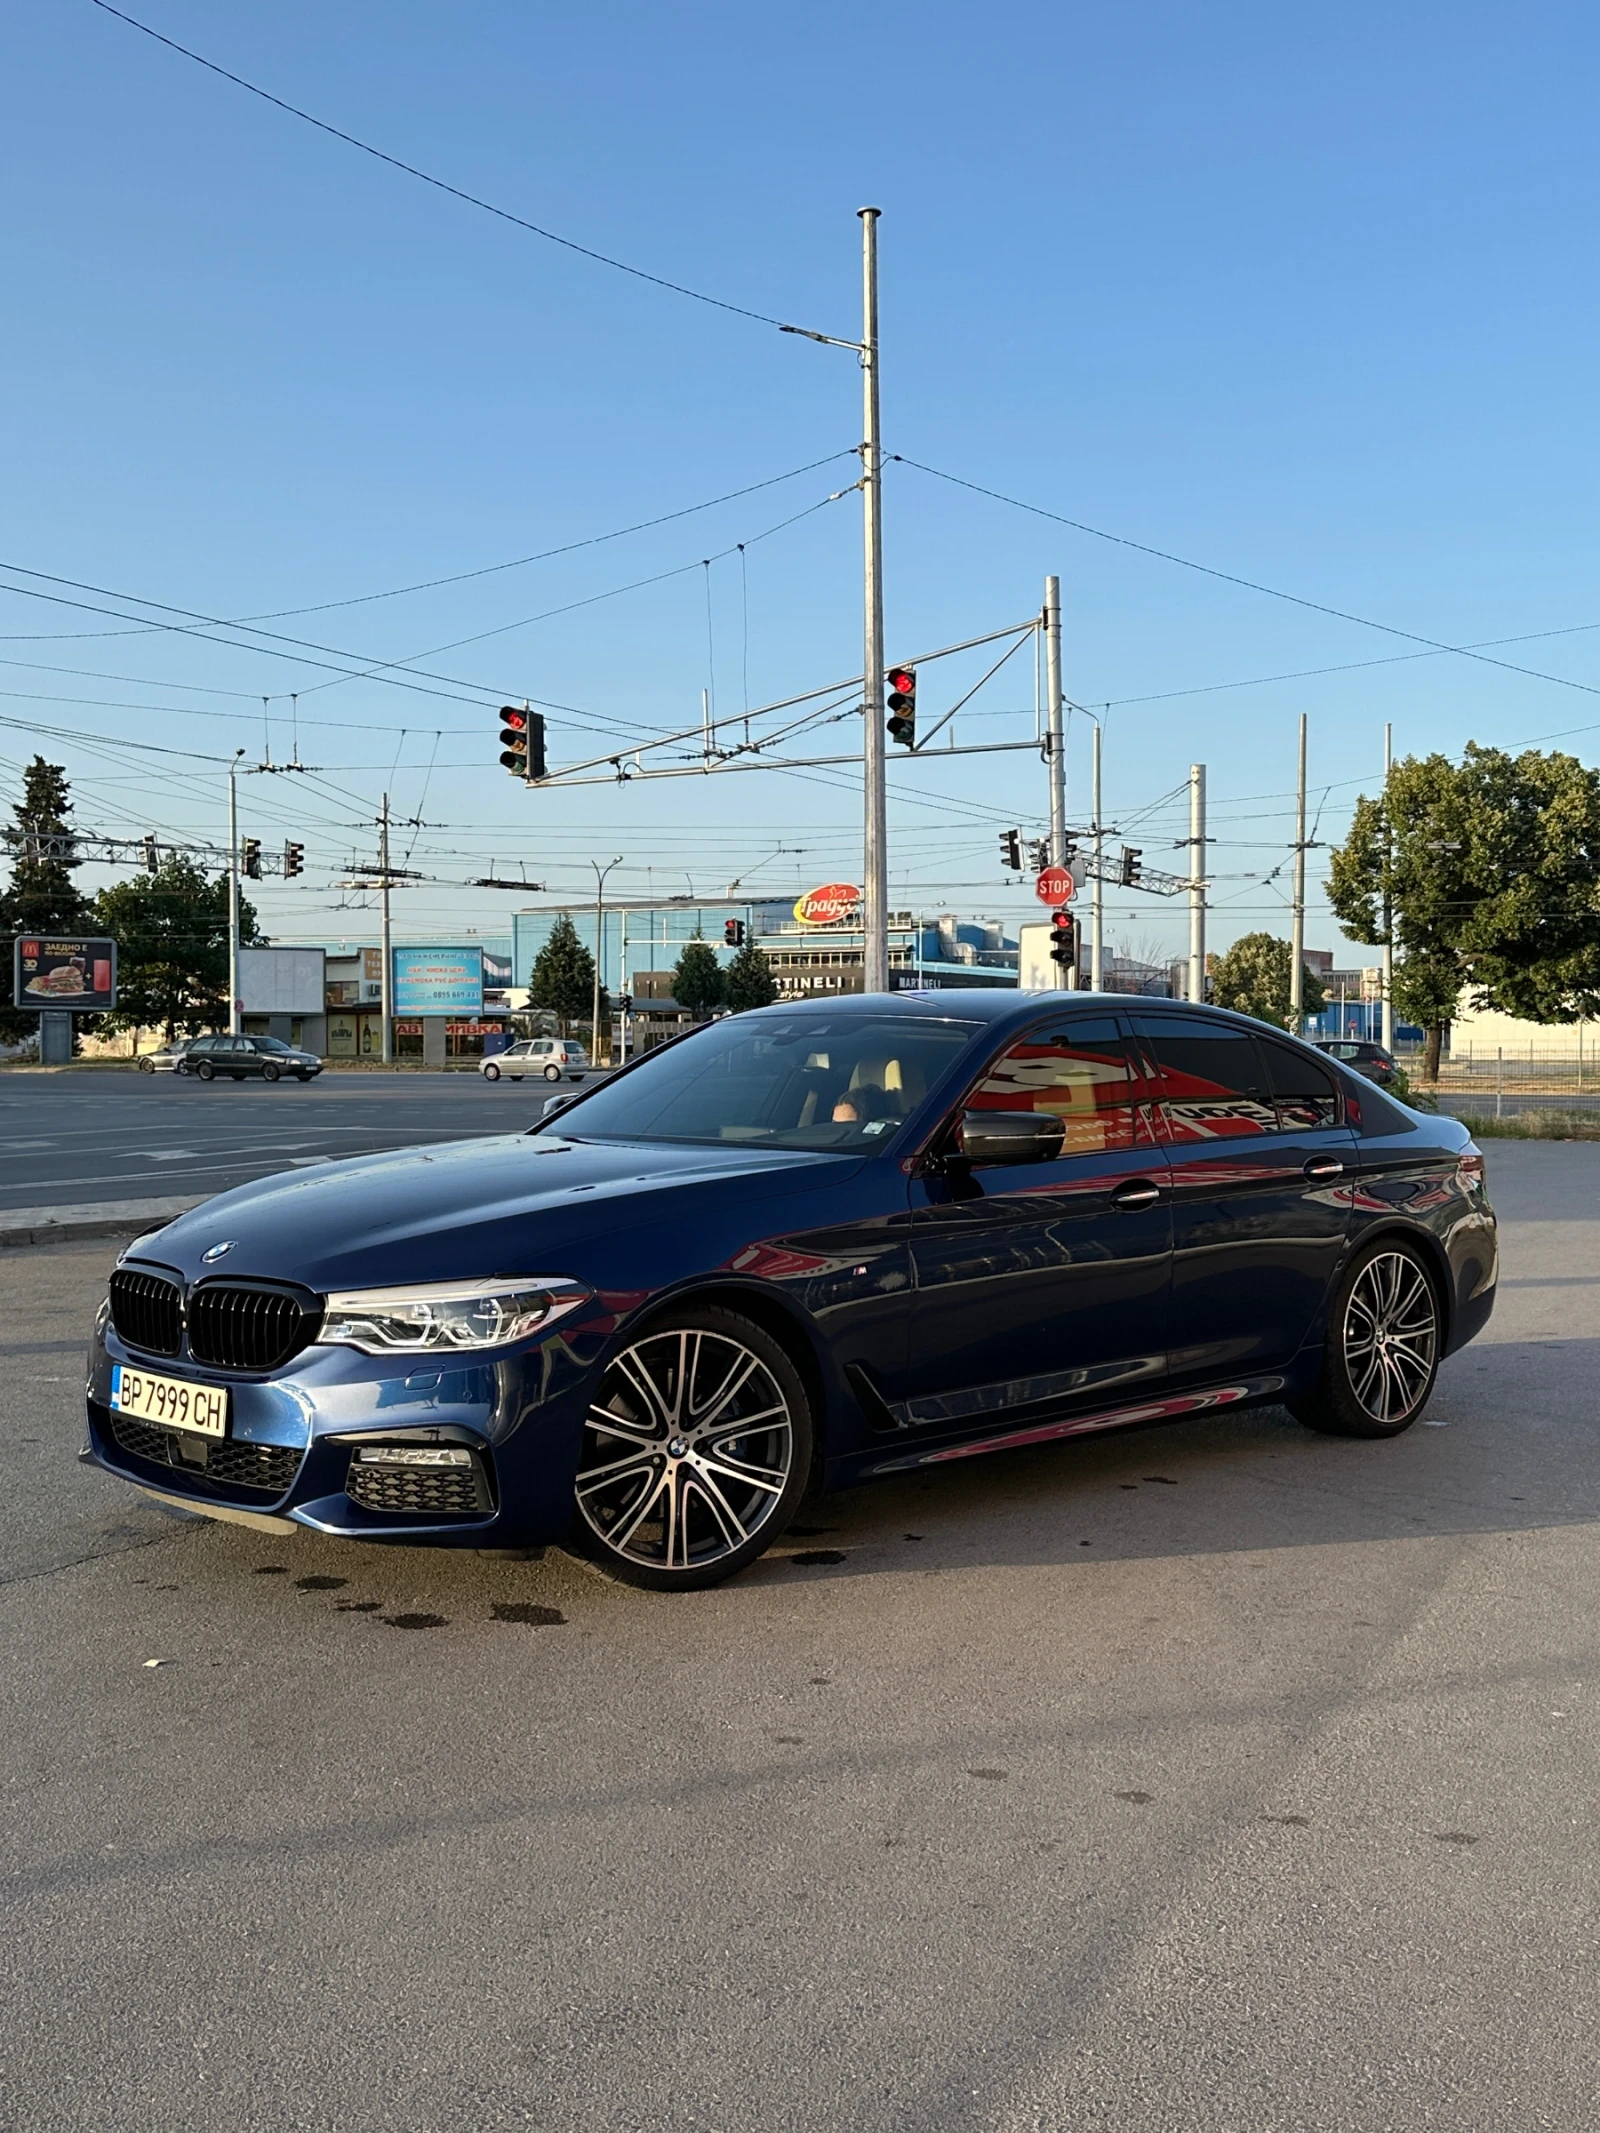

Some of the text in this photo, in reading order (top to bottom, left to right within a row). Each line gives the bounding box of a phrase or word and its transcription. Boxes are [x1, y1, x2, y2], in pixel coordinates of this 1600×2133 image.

[1040, 880, 1070, 894] STOP
[45, 943, 81, 953] ЗАЕДНО
[23, 959, 38, 968] 30
[771, 976, 842, 989] RTINELI
[899, 976, 941, 989] MARTNELI
[433, 991, 451, 999] 0895
[452, 991, 465, 999] 669
[121, 1373, 222, 1430] BP 7999 CH
